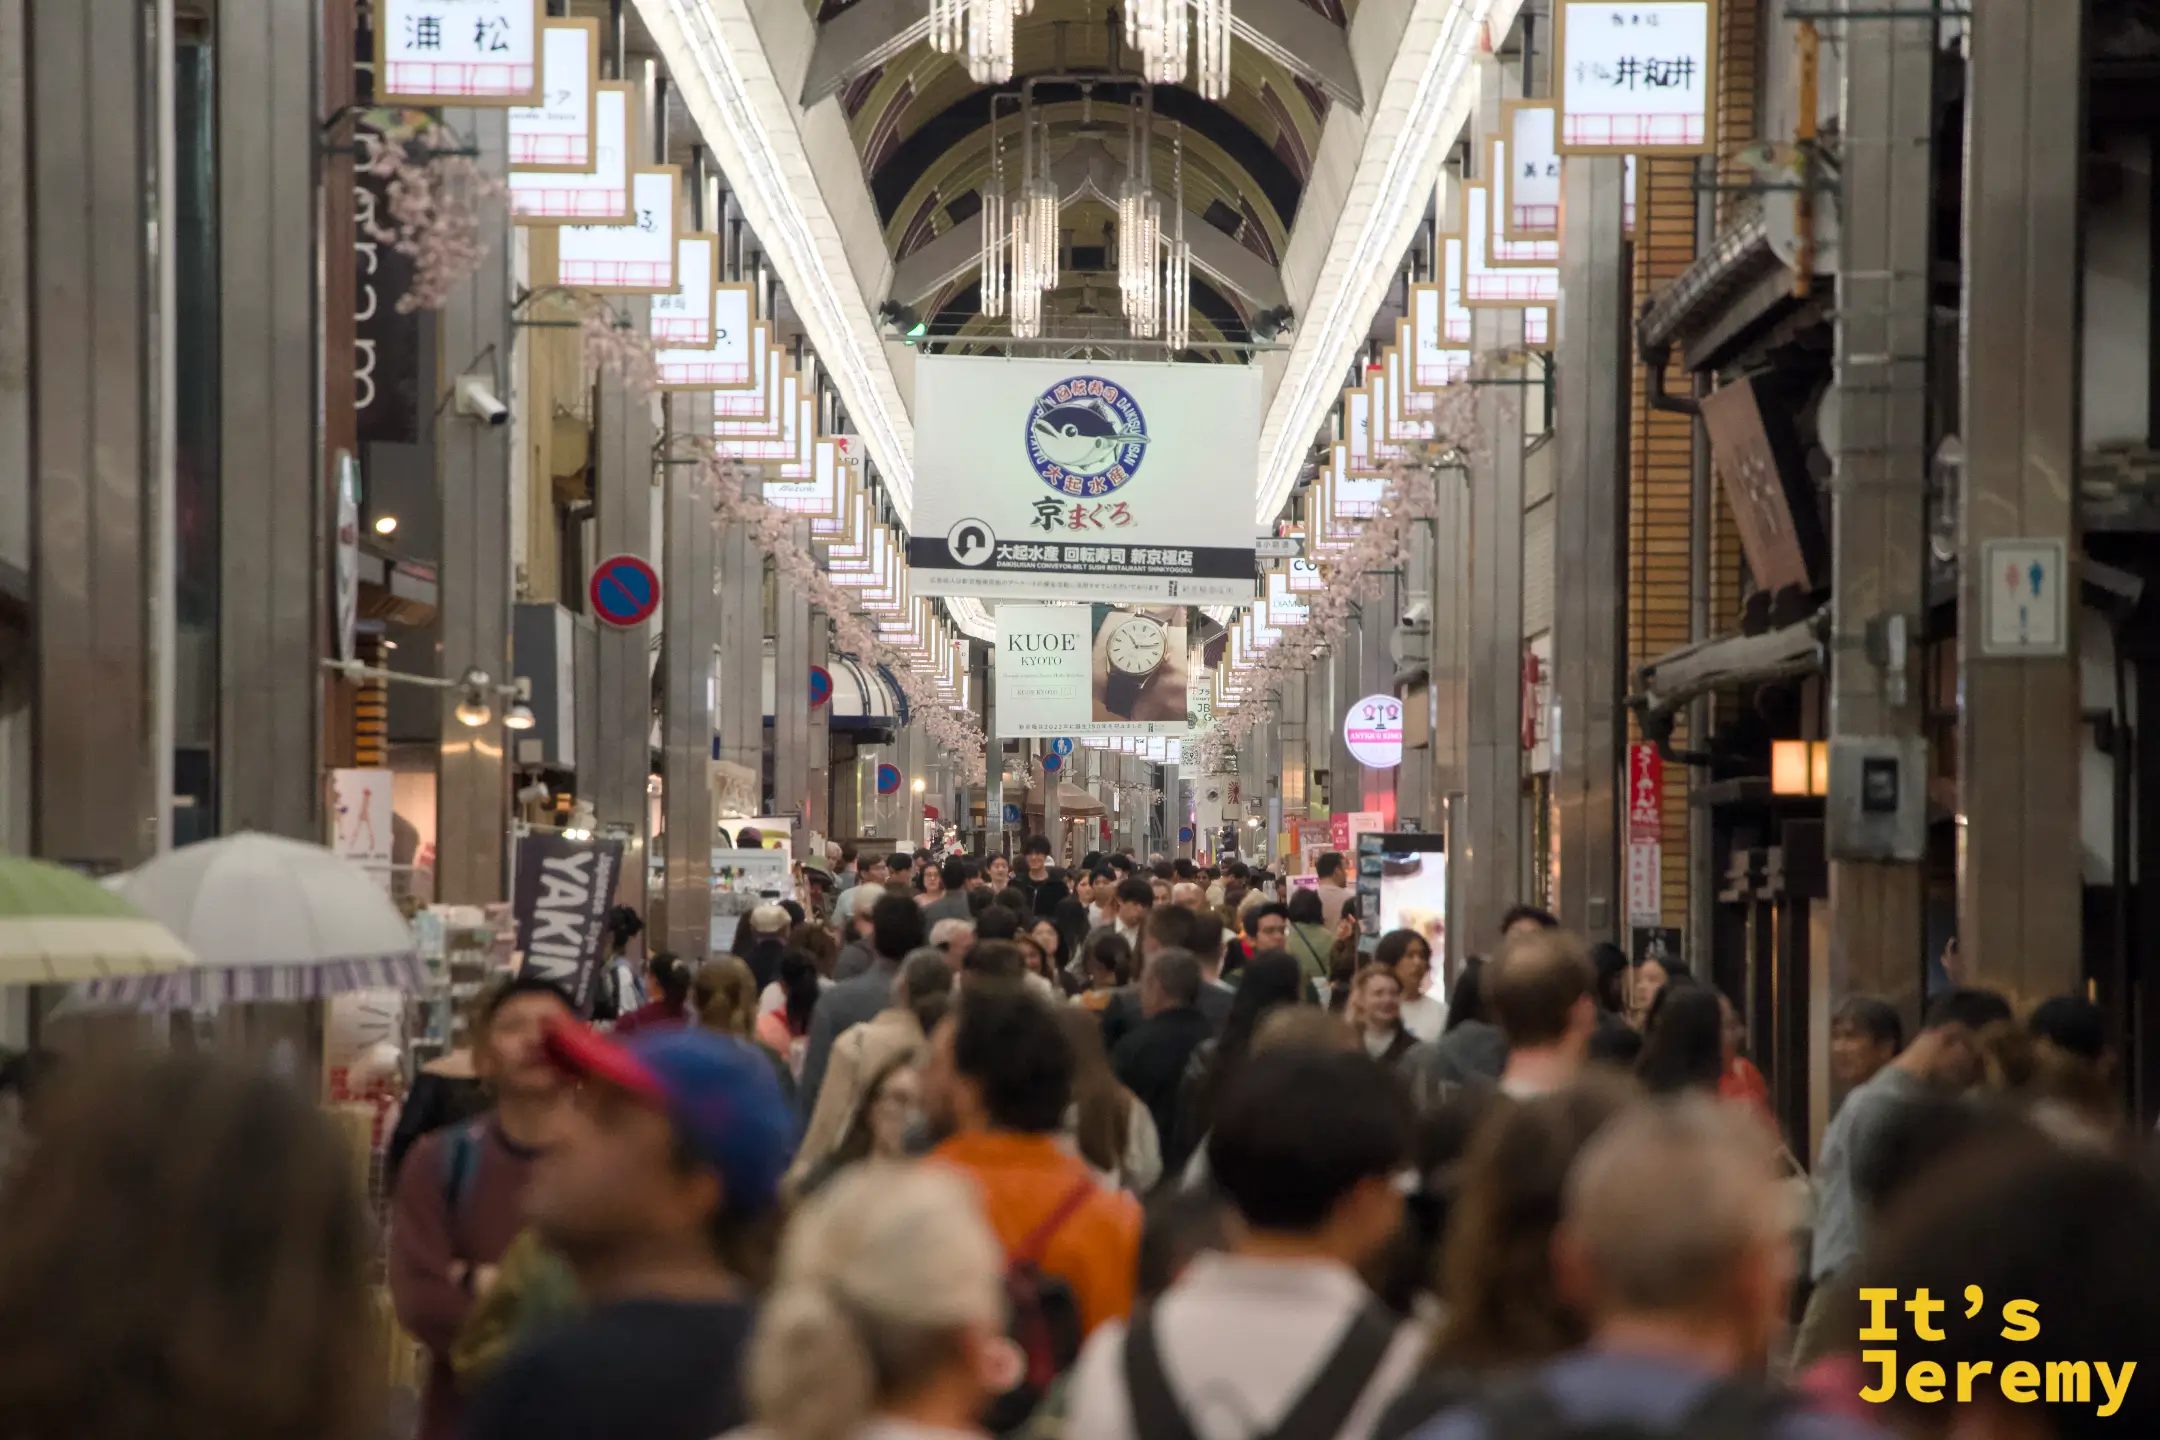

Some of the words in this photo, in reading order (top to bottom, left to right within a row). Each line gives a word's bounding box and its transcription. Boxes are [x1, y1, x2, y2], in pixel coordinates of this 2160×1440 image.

[1053, 379, 1119, 405] 回転寿司
[1042, 463, 1130, 495] 大起水産
[1031, 496, 1132, 531] 京まぐろ
[996, 544, 1060, 562] 大起水産
[1064, 547, 1126, 565] 回転寿司
[1130, 548, 1193, 567] 新京極店
[1088, 564, 1106, 572] SUSHI
[1107, 565, 1146, 573] RESTAURANT
[1008, 633, 1075, 652] KUOE
[1021, 656, 1062, 666] KYOTO
